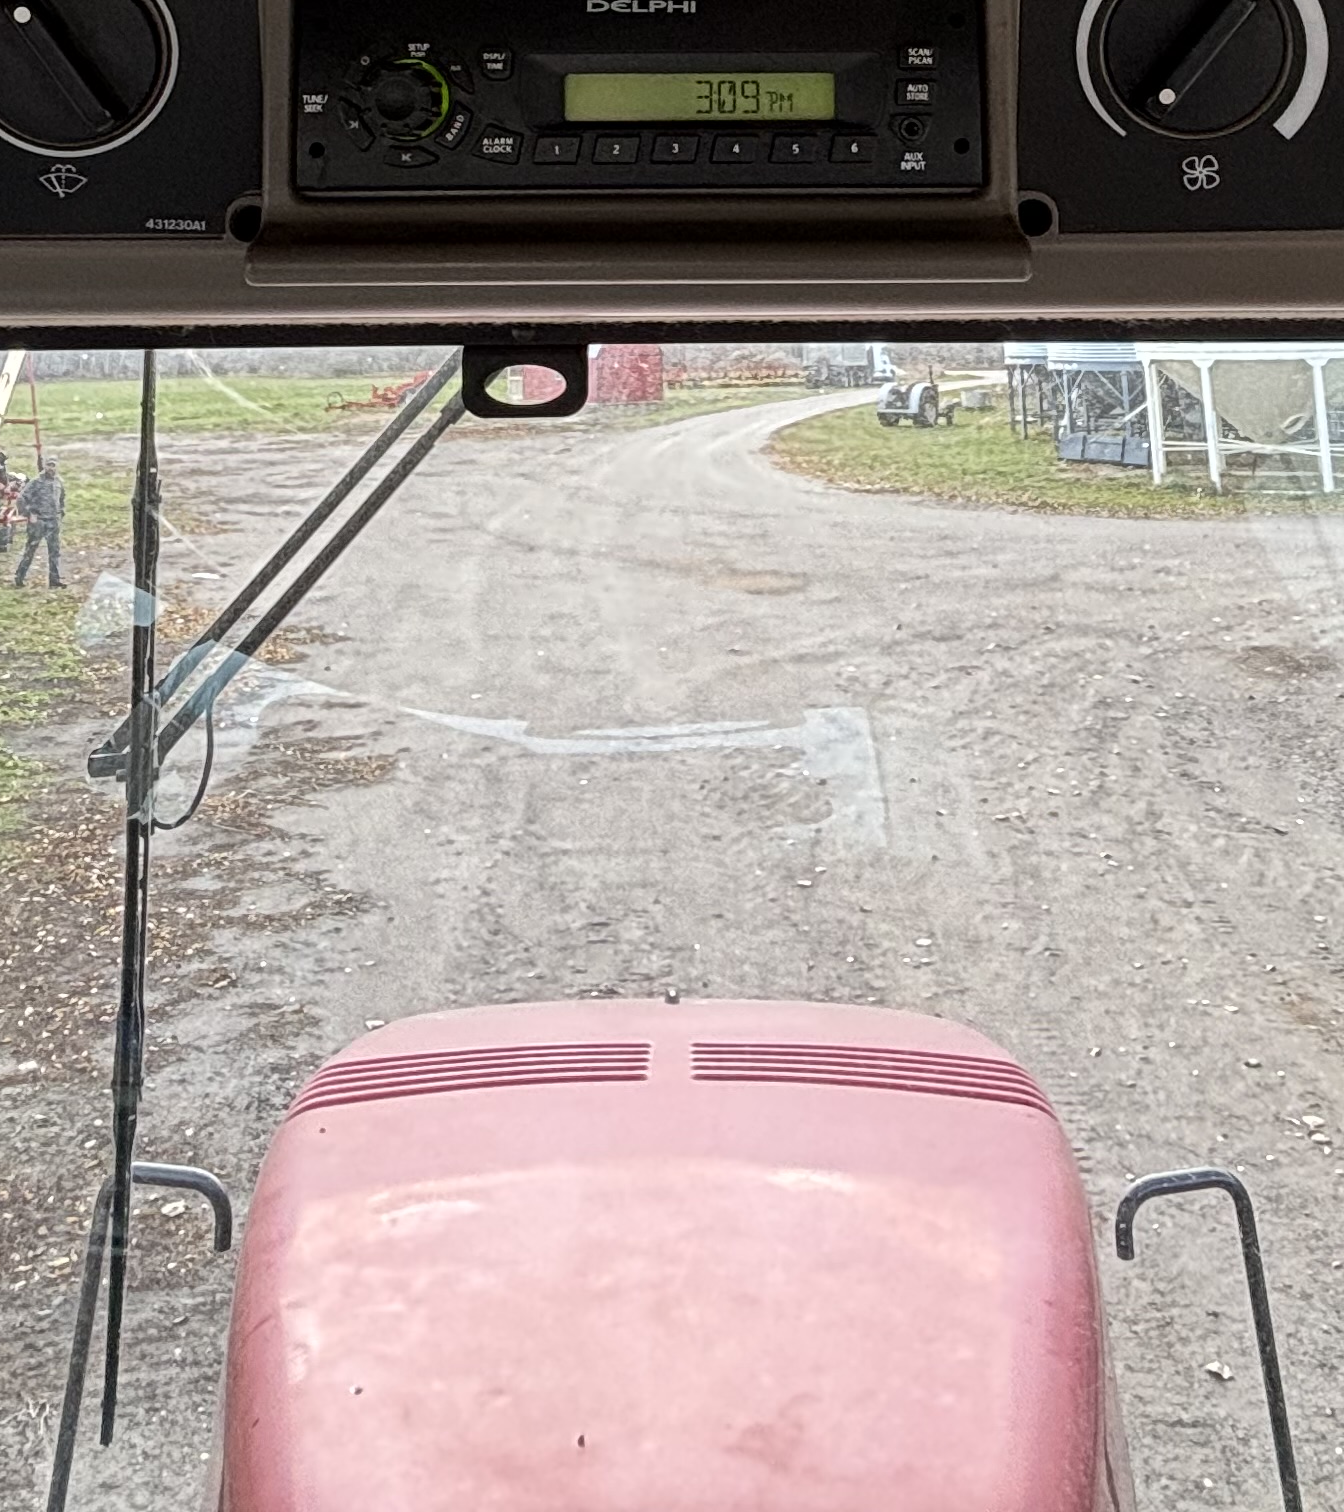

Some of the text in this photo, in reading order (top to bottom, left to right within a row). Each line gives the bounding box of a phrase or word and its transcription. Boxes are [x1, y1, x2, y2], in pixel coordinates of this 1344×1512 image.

[586, 0, 697, 14] DELPHI
[907, 84, 929, 92] AUTO
[906, 92, 930, 101] STORE
[303, 104, 323, 113] SEEK
[444, 113, 465, 142] BAND
[482, 136, 514, 147] ALARM
[482, 144, 513, 154] CLOCK
[612, 144, 620, 156] 2
[671, 143, 680, 155] 3
[732, 143, 741, 155] 4
[792, 144, 801, 155] 5
[850, 143, 859, 155] 6
[904, 151, 924, 161] AUX
[900, 161, 927, 171] INPUT
[145, 218, 206, 231] 431230A1
